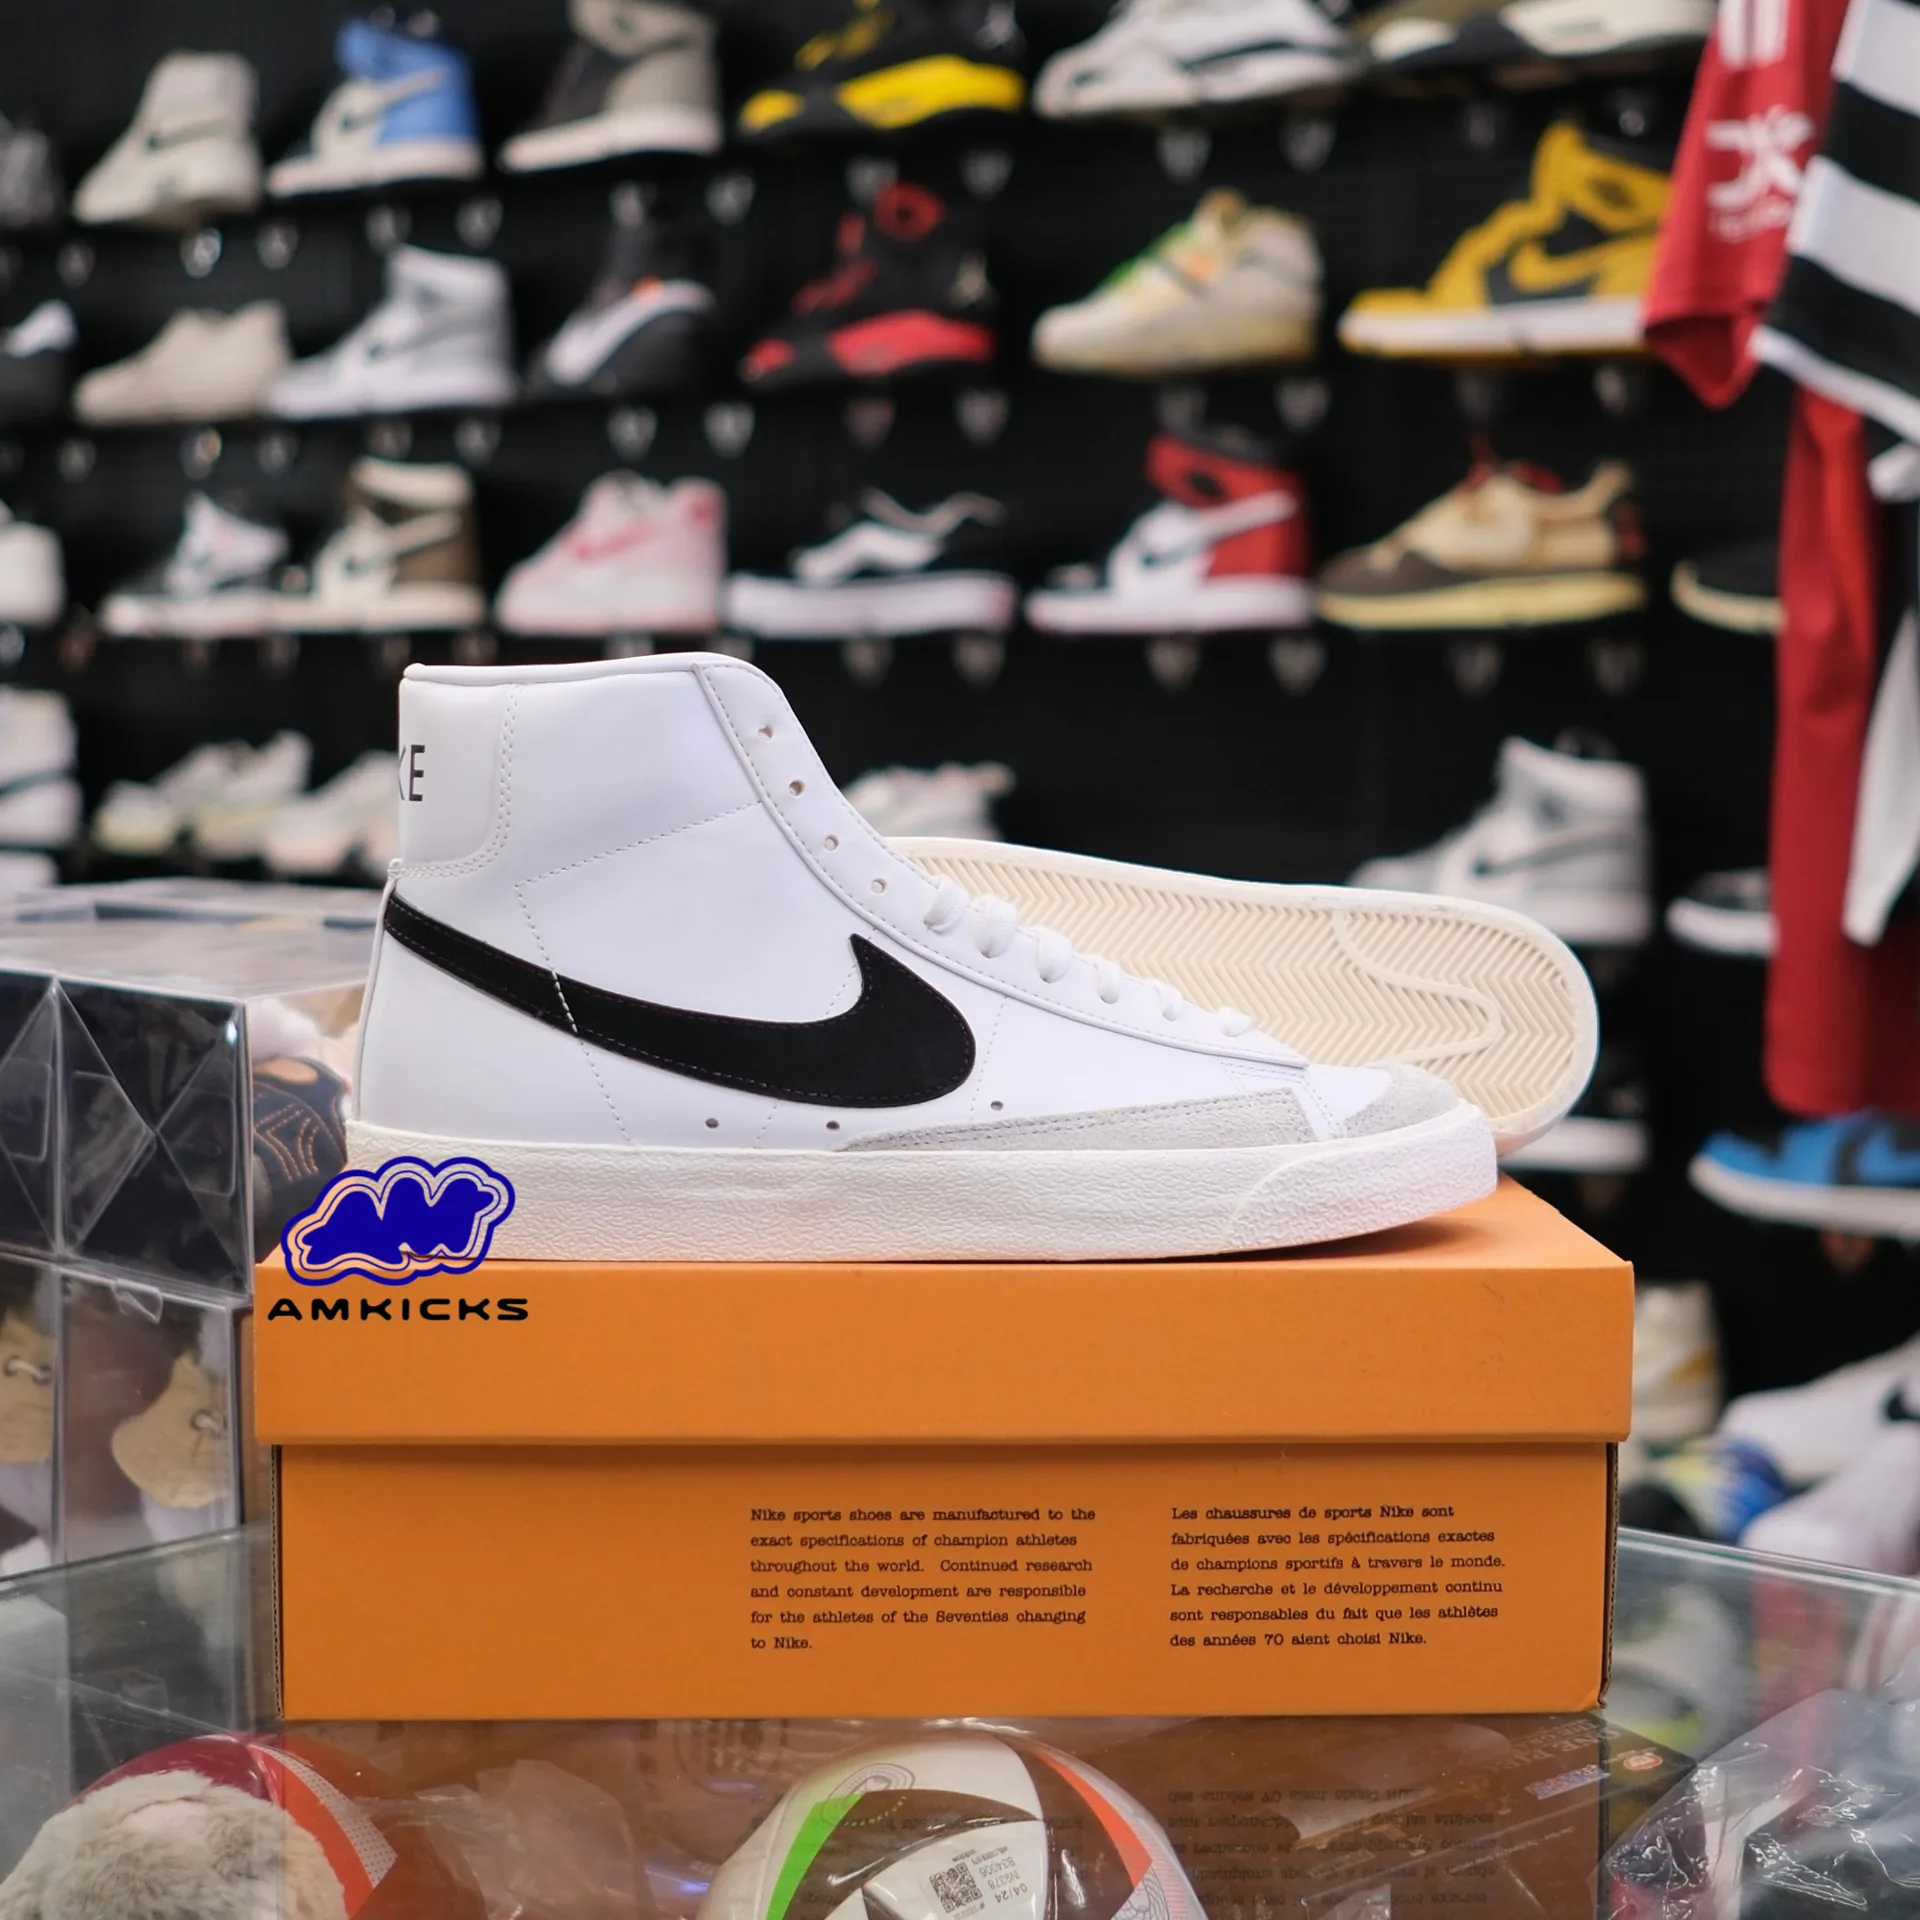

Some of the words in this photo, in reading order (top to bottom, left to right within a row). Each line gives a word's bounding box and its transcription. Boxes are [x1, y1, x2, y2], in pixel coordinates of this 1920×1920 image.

[750, 1508, 786, 1522] Nike
[792, 1509, 842, 1524] sports
[849, 1508, 893, 1522] shoes
[899, 1510, 926, 1521] are
[932, 1507, 1041, 1521] manufactured
[1047, 1509, 1064, 1521] to
[1070, 1507, 1096, 1521] the
[1171, 1507, 1198, 1520] Les
[1205, 1507, 1292, 1520] chaussures
[1298, 1506, 1317, 1519] de
[1323, 1506, 1373, 1521] sports
[1379, 1504, 1415, 1518] Nike
[1421, 1505, 1455, 1518] sont
[750, 1535, 793, 1547] exact
[799, 1534, 905, 1550] specifications
[911, 1533, 929, 1547] of
[933, 1533, 1009, 1549] champion
[1015, 1533, 1078, 1547] athletes
[1171, 1532, 1250, 1548] fabriquées
[1256, 1534, 1292, 1545] avec
[1298, 1531, 1321, 1545] les
[1327, 1530, 1431, 1547] spécifications
[1437, 1530, 1496, 1543] exactes
[750, 1559, 838, 1575] throughout
[844, 1559, 870, 1573] the
[876, 1559, 925, 1573] world.
[939, 1559, 1019, 1572] Continued
[1025, 1558, 1093, 1572] research
[1170, 1557, 1189, 1571] de
[1196, 1557, 1278, 1573] champions
[1285, 1556, 1344, 1573] sportifs
[1350, 1556, 1361, 1570] à
[1367, 1557, 1423, 1569] travers
[1430, 1555, 1444, 1569] le
[1450, 1554, 1506, 1568] monde.
[750, 1585, 780, 1598] and
[786, 1585, 854, 1598] constant
[860, 1584, 960, 1601] development
[965, 1586, 992, 1598] are
[998, 1584, 1087, 1600] responsible
[1170, 1583, 1191, 1597] La
[1196, 1582, 1274, 1596] recherche
[1280, 1583, 1296, 1595] et
[1302, 1582, 1317, 1595] le
[1323, 1581, 1439, 1597] développement
[1445, 1580, 1503, 1594] continu
[750, 1610, 773, 1624] for
[779, 1610, 806, 1624] the
[812, 1610, 875, 1624] athletes
[881, 1610, 898, 1624] of
[902, 1610, 929, 1624] the
[935, 1610, 1009, 1624] Seventies
[1016, 1609, 1087, 1625] changing
[1169, 1609, 1204, 1622] sont
[1210, 1607, 1309, 1624] responsables
[1315, 1607, 1336, 1621] du
[1342, 1607, 1369, 1620] fait
[1375, 1608, 1403, 1622] que
[1409, 1606, 1431, 1620] les
[1437, 1605, 1499, 1619] athlètes
[750, 1637, 767, 1650] to
[773, 1636, 813, 1650] Nike.
[1169, 1633, 1196, 1648] des
[1202, 1633, 1257, 1647] années
[1264, 1632, 1285, 1646] 70
[1291, 1633, 1331, 1646] aient
[1336, 1632, 1382, 1646] choisi
[1388, 1631, 1427, 1645] Nike.
[994, 1882, 1028, 1904] 04/24
